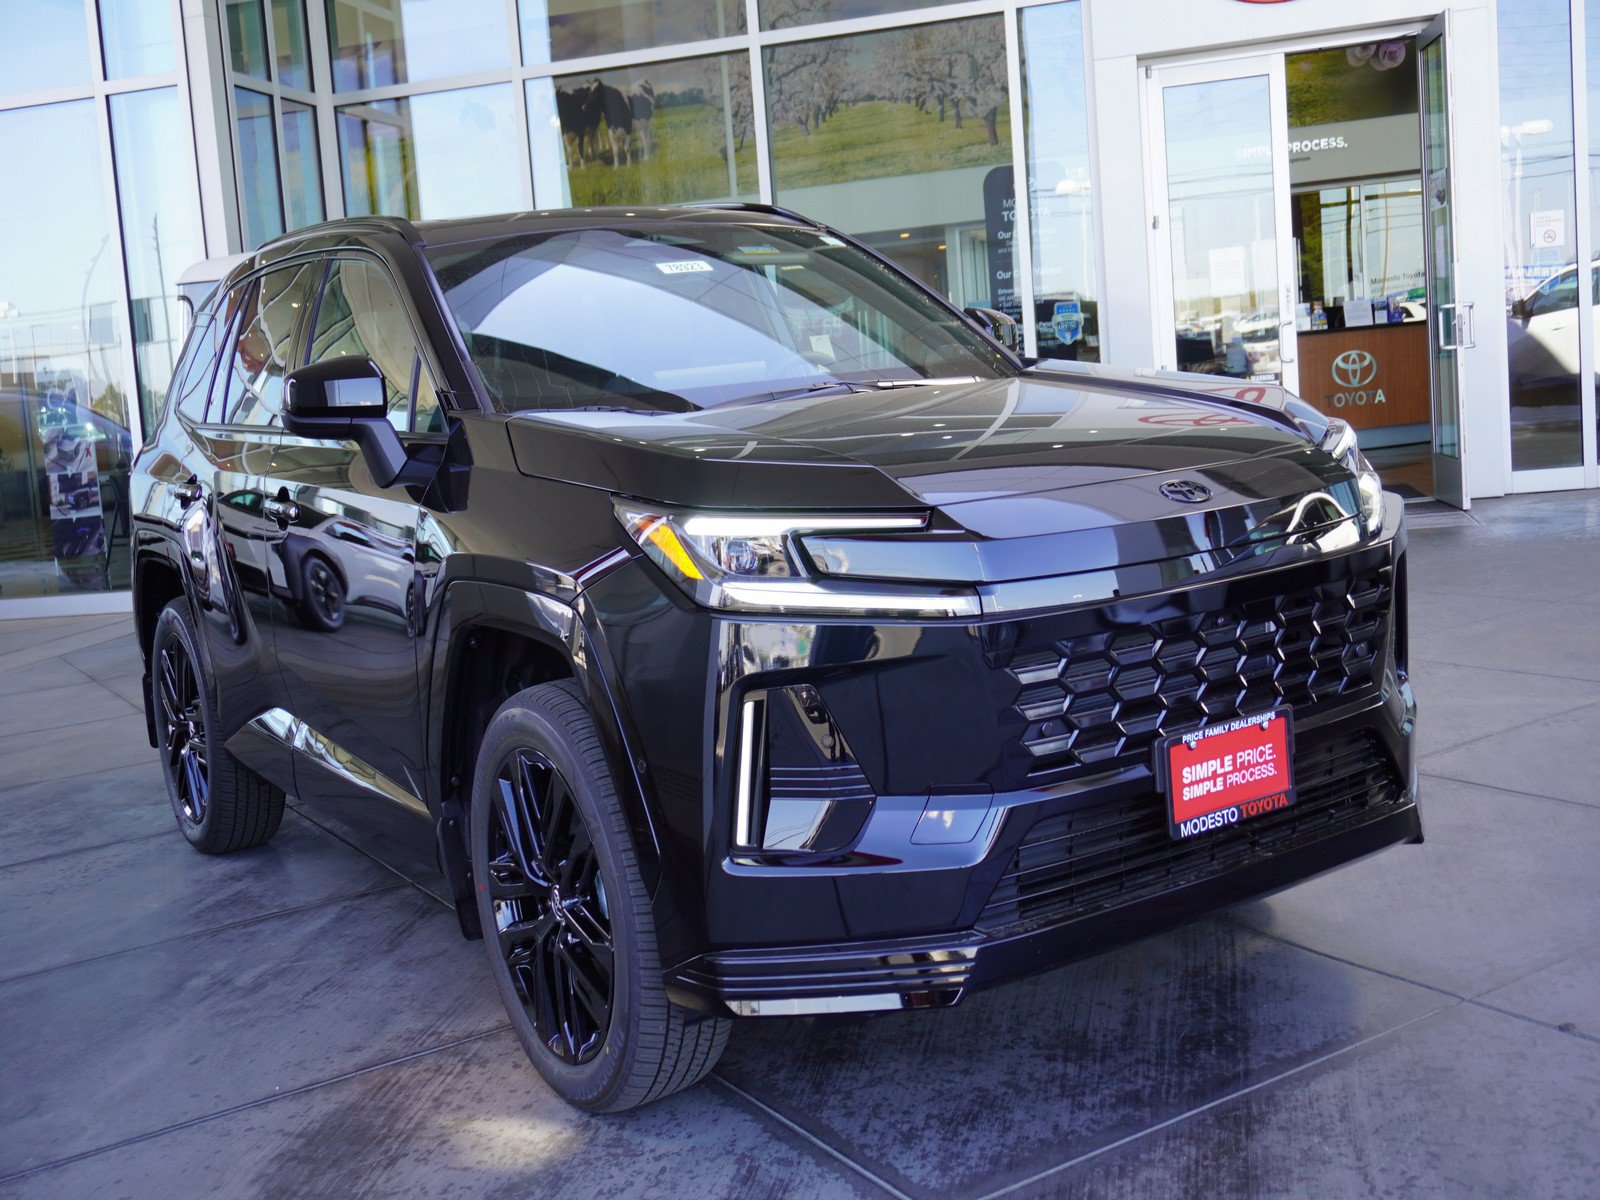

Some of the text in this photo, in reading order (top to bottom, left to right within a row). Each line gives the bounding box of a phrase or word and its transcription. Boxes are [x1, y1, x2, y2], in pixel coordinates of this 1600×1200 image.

[1234, 145, 1272, 160] SIMPL
[997, 231, 1012, 239] Our
[996, 271, 1012, 280] Our
[1324, 388, 1386, 408] TOYOTA
[1182, 711, 1276, 743] PRICE FAMILY DEALERSHIPS
[1182, 743, 1276, 784] SIMPLE PRICE.
[1182, 763, 1277, 801] SIMPLE PROCESS.
[1180, 793, 1288, 838] MODESTO TOYOTA
